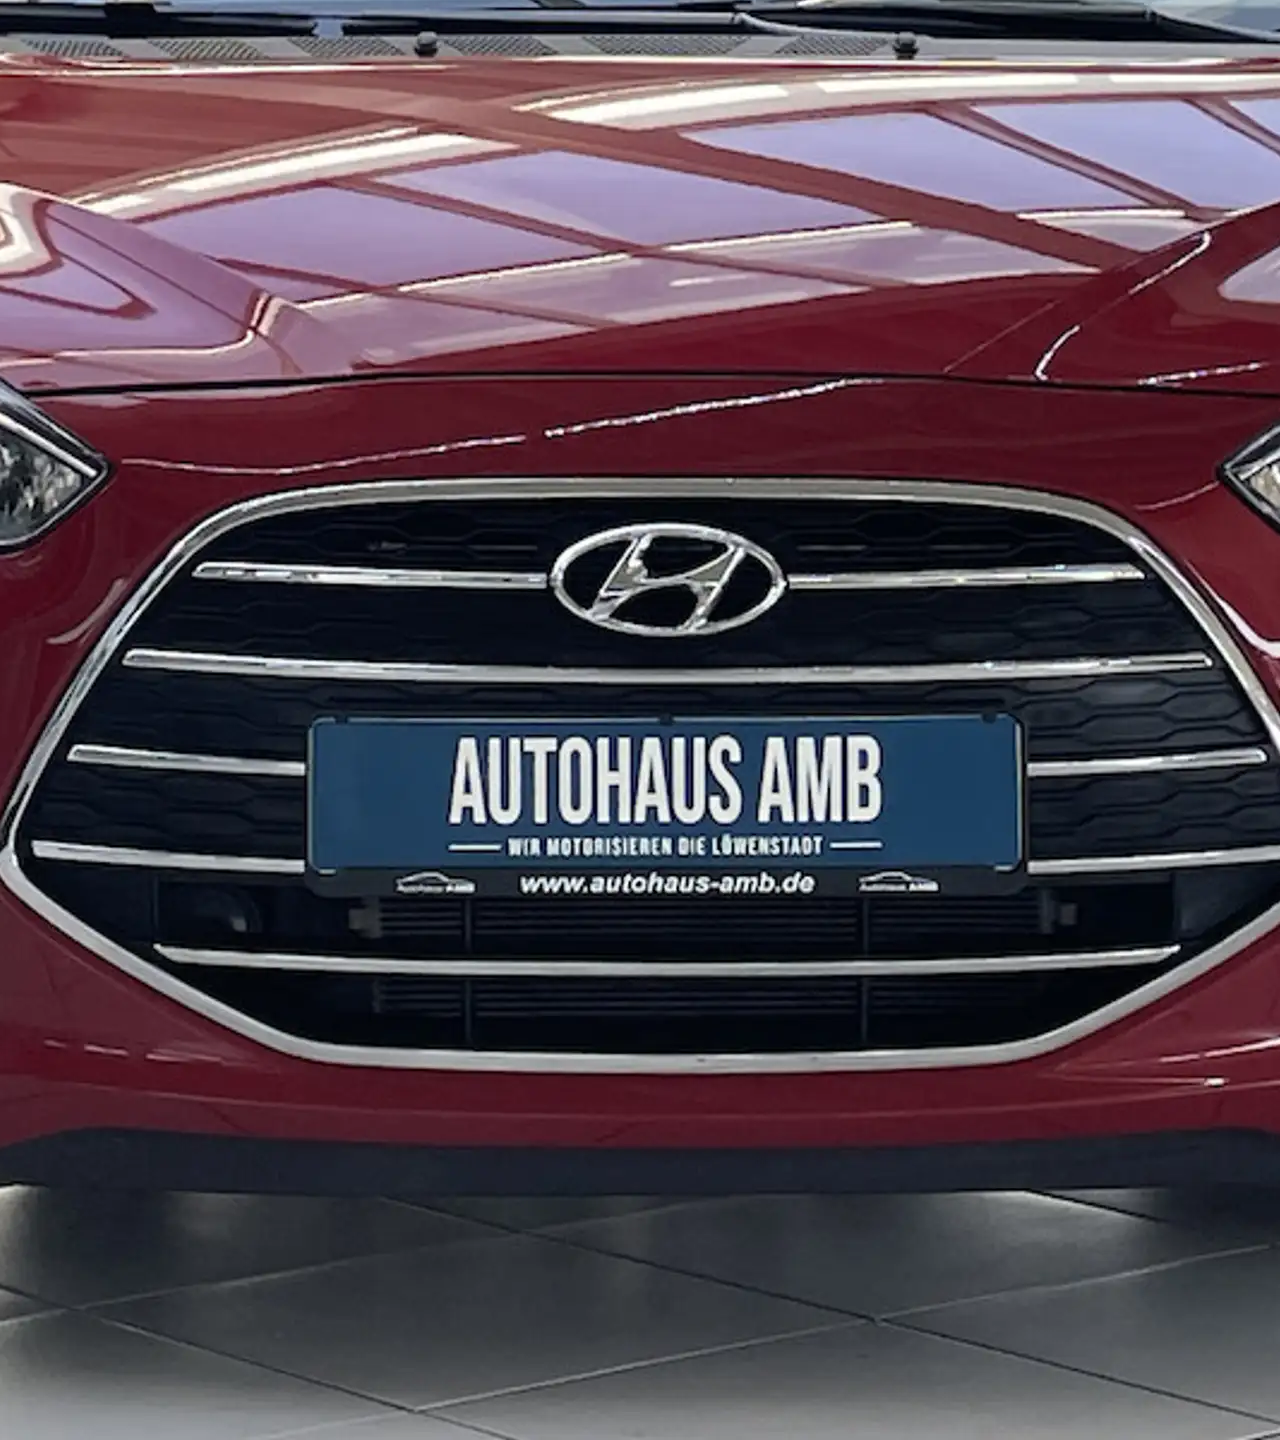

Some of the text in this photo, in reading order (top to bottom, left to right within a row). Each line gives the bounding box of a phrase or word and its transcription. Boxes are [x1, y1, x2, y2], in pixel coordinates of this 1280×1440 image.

[448, 734, 883, 825] AUTOHAUS AMB
[508, 834, 824, 857] WIR MOTORISIEREN DIE LÖWENSTADT
[520, 871, 815, 894] www.autohaus-amb.de
